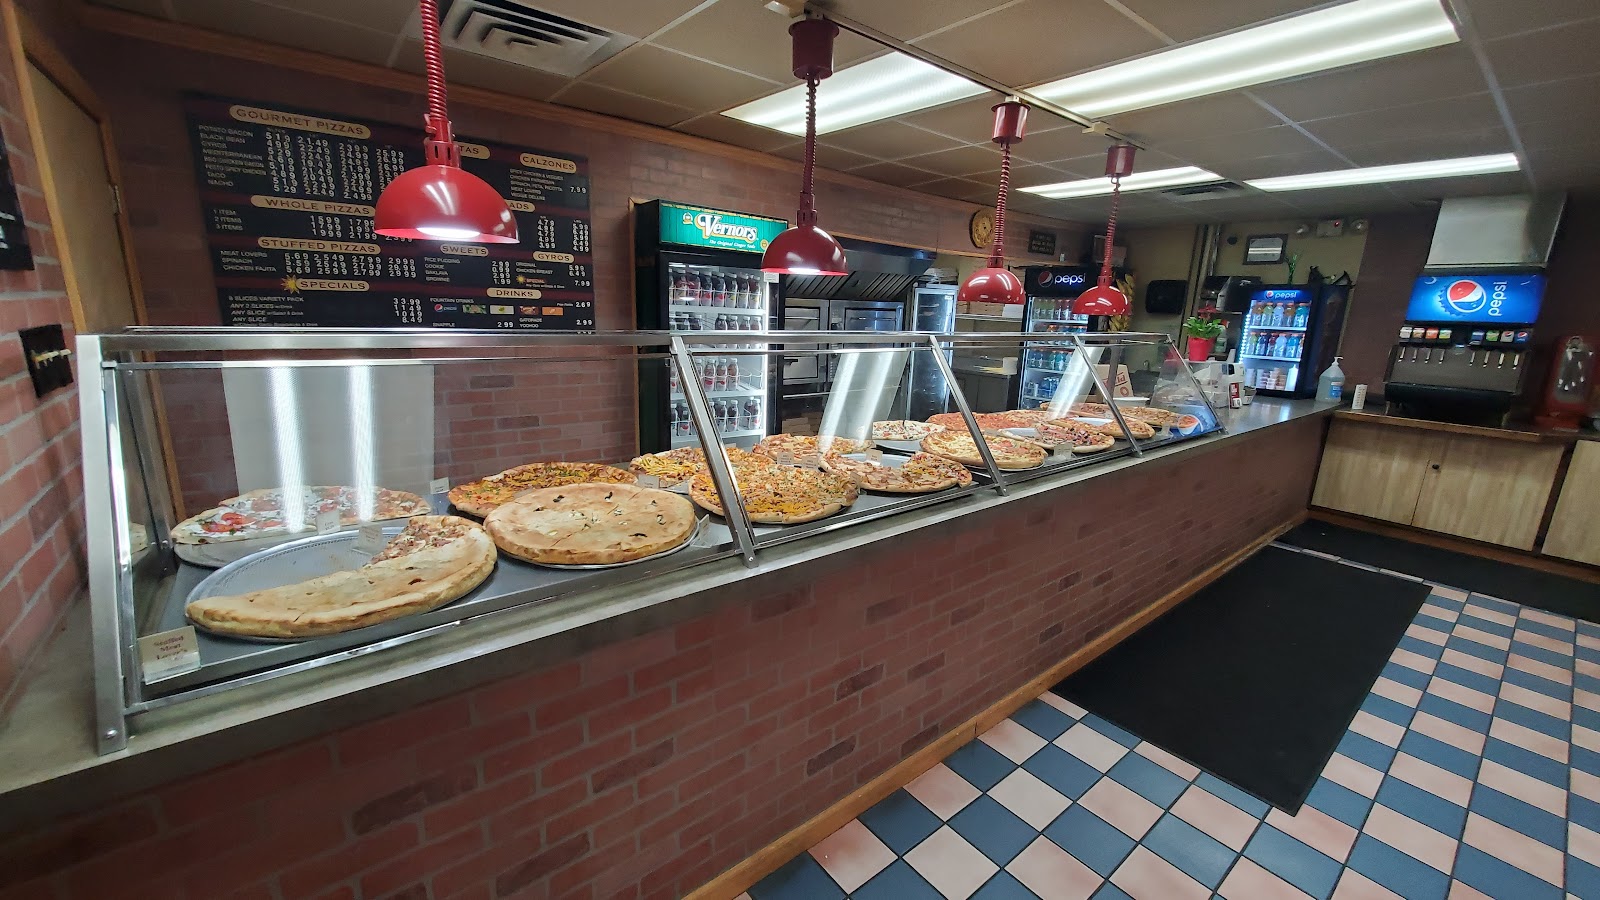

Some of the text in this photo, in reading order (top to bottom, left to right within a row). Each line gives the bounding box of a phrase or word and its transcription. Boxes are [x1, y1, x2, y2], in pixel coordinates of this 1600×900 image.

[236, 109, 363, 135] GOURMET PIZZAS
[522, 156, 575, 171] CALZONES
[266, 198, 370, 216] WHOLE PIZZAS
[697, 214, 757, 241] Vernors
[262, 238, 376, 252] STUFFED PIZZAS
[442, 246, 487, 255] SWEETS
[538, 254, 570, 262] GYROS
[300, 280, 366, 290] SPECIALS
[1054, 273, 1086, 285] pepsi
[1488, 281, 1508, 317] pepsi
